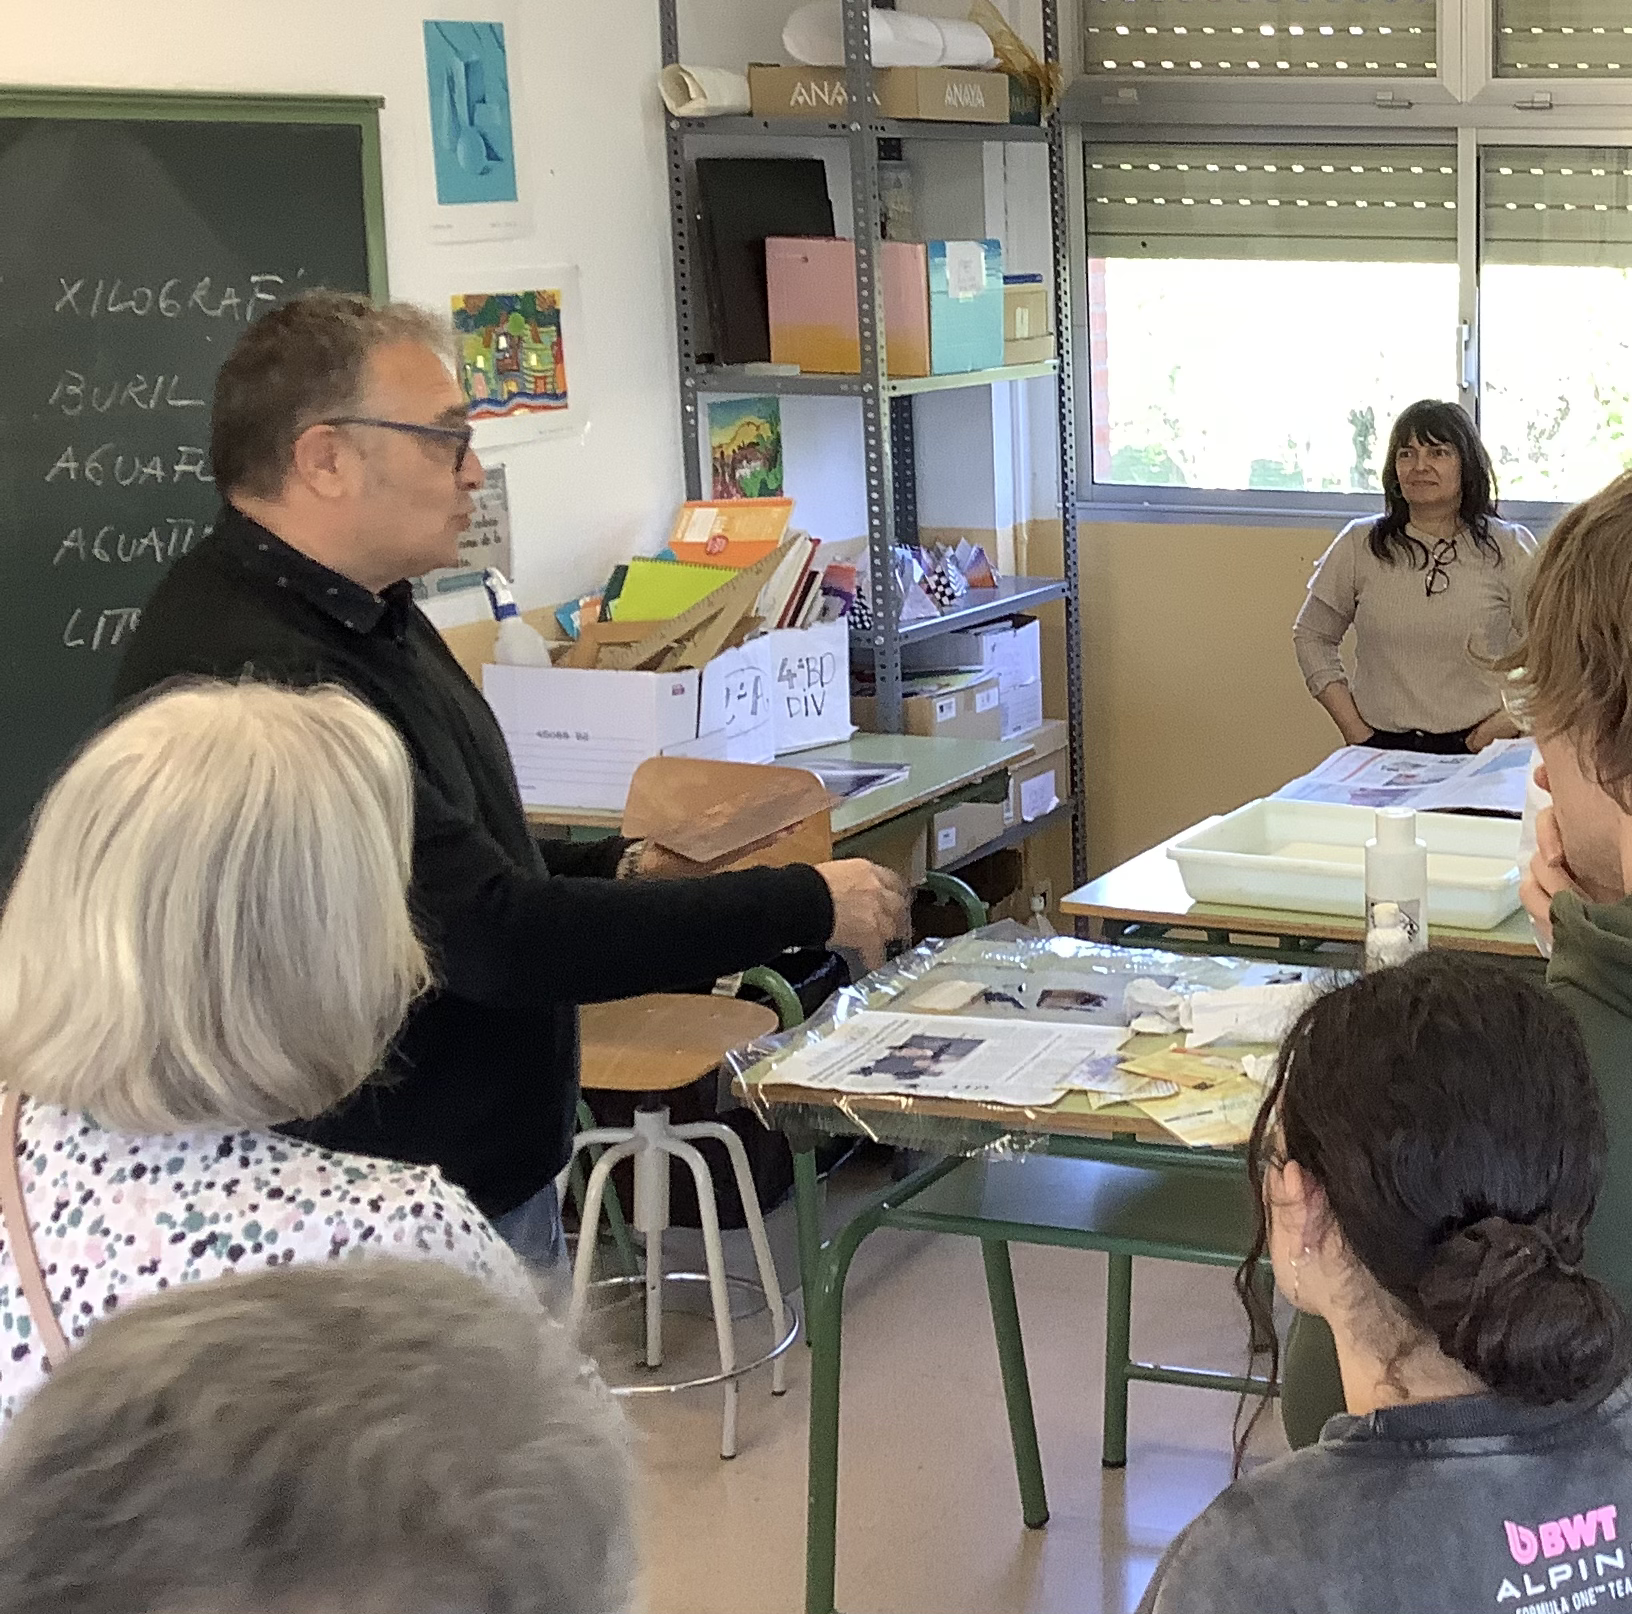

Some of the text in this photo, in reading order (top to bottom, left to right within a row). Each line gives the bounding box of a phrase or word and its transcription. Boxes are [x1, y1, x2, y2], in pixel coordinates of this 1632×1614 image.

[789, 81, 882, 107] ANA
[945, 84, 985, 108] ANAYA
[54, 268, 304, 322] XILOGRAF
[49, 369, 205, 416] BURIL
